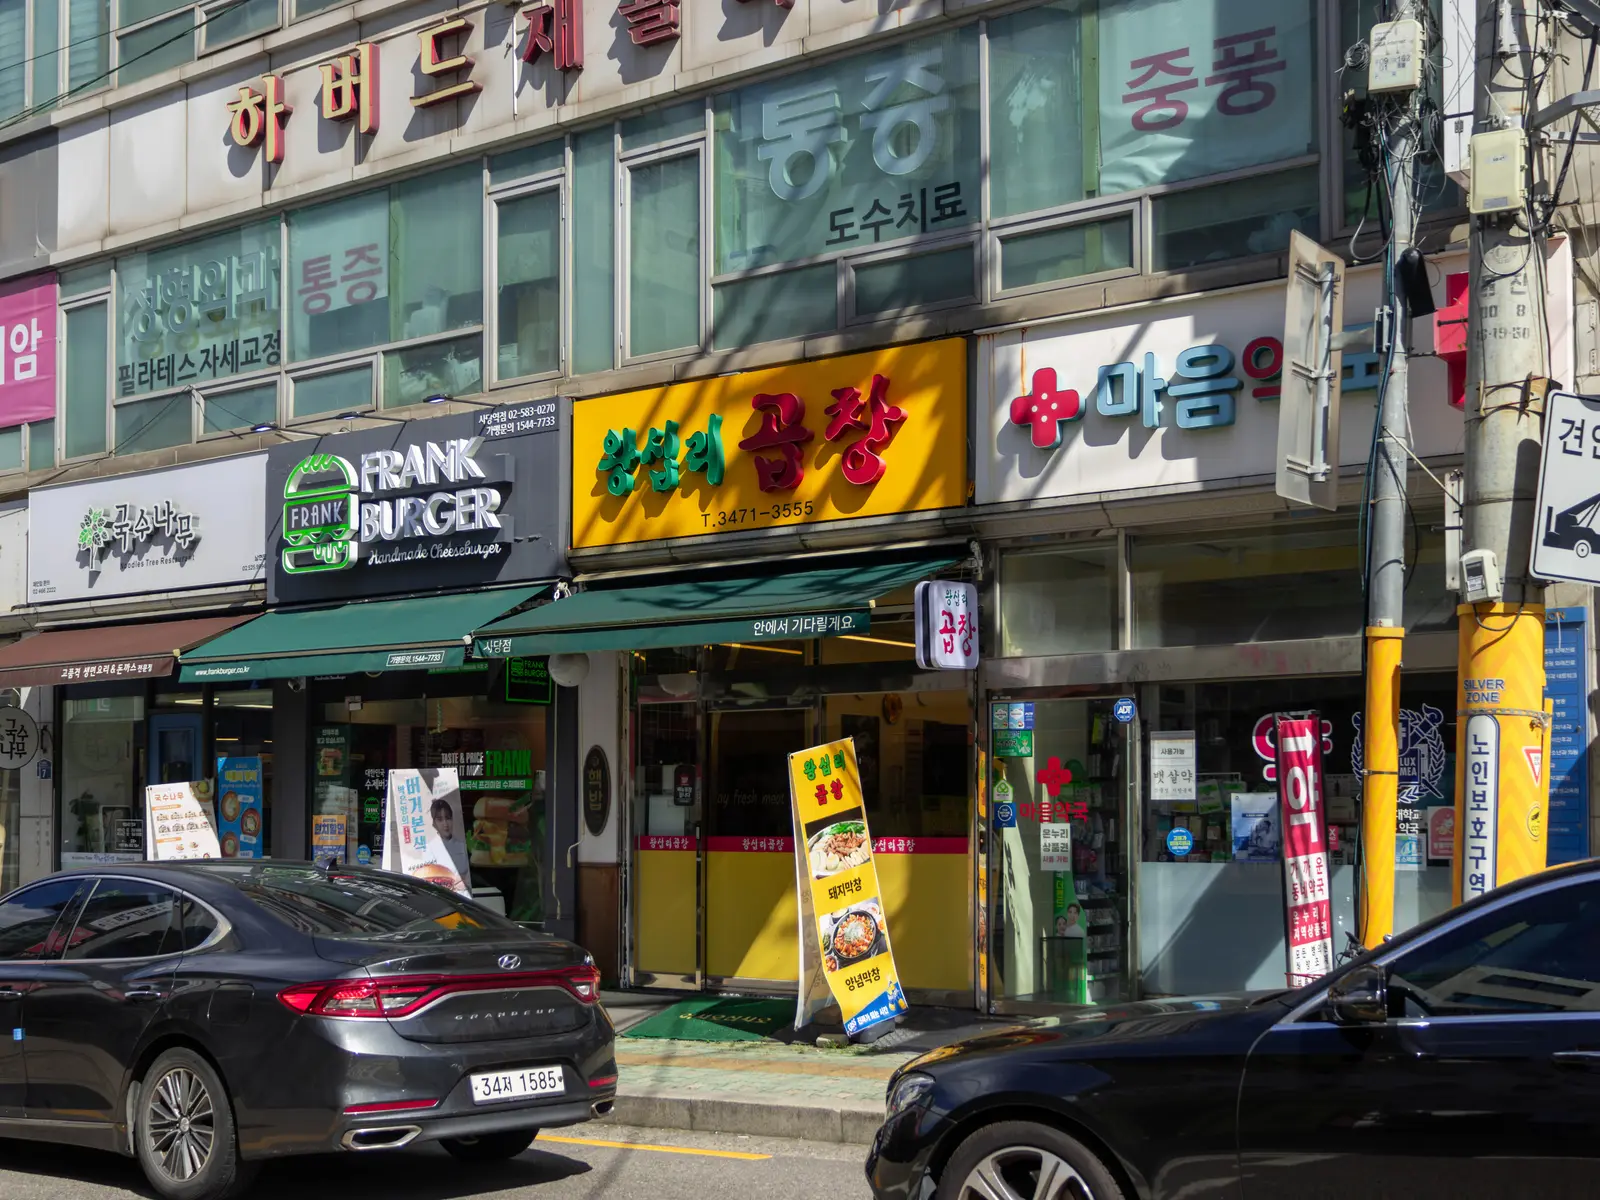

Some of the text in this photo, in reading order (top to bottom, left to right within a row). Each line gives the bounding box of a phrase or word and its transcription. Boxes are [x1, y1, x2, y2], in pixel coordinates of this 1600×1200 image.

[1121, 26, 1287, 132] 중풍
[757, 46, 951, 201] 통증
[824, 180, 969, 247] 도수치료
[298, 242, 384, 316] 통증
[123, 246, 282, 343] 정형외과
[508, 403, 556, 420] 02-583-0270
[516, 415, 556, 433] 1544-7733
[597, 373, 909, 497] 왕십리 곱창
[361, 436, 487, 494] FRANK
[290, 500, 343, 530] FRANK
[361, 487, 502, 543] BURGER
[700, 499, 815, 529] T.3471-3555
[112, 499, 196, 553] 국수나무
[145, 559, 160, 568] Tree
[160, 555, 196, 566] Restaurant
[367, 541, 502, 566] Handmade Cheeseburger
[945, 588, 969, 607] 왕십리
[753, 615, 857, 636] 안에서 기다릴게요.
[938, 609, 977, 657] 곱창
[483, 638, 512, 654] 사당점
[411, 653, 441, 663] 1544-7733
[524, 660, 545, 669] FRANK
[60, 667, 82, 679] 고품격
[195, 665, 250, 677] www.frankburger.co.kr
[524, 669, 547, 678] BURGER
[1463, 679, 1505, 691] SILVER
[1465, 692, 1501, 704] ZONE
[1117, 705, 1133, 714] ADT
[5, 718, 29, 744] 국수
[0, 741, 28, 761] 나무
[441, 752, 459, 764] TASTE
[466, 752, 484, 763] PRICE
[1160, 747, 1186, 755] 사용가능
[486, 749, 533, 777] FRANK
[803, 749, 847, 781] 왕십리
[1400, 756, 1416, 766] LUX
[364, 768, 386, 778] 대한민국
[1400, 767, 1417, 776] MEA
[460, 780, 478, 789] 미국식
[478, 780, 501, 789] 프리미엄
[814, 778, 844, 806] 곱창
[153, 791, 185, 802] 국수나무
[1019, 801, 1089, 824] 마음약국
[1042, 828, 1069, 839] 온누리
[649, 837, 689, 850] 왕십리곱창
[742, 838, 785, 851] 왕십리곱창
[1042, 842, 1069, 852] 상품권
[828, 876, 863, 900] 돼지막창
[844, 966, 881, 992] 양념막창
[454, 1007, 556, 1020] GRANDEUR
[519, 1070, 557, 1091] 1585
